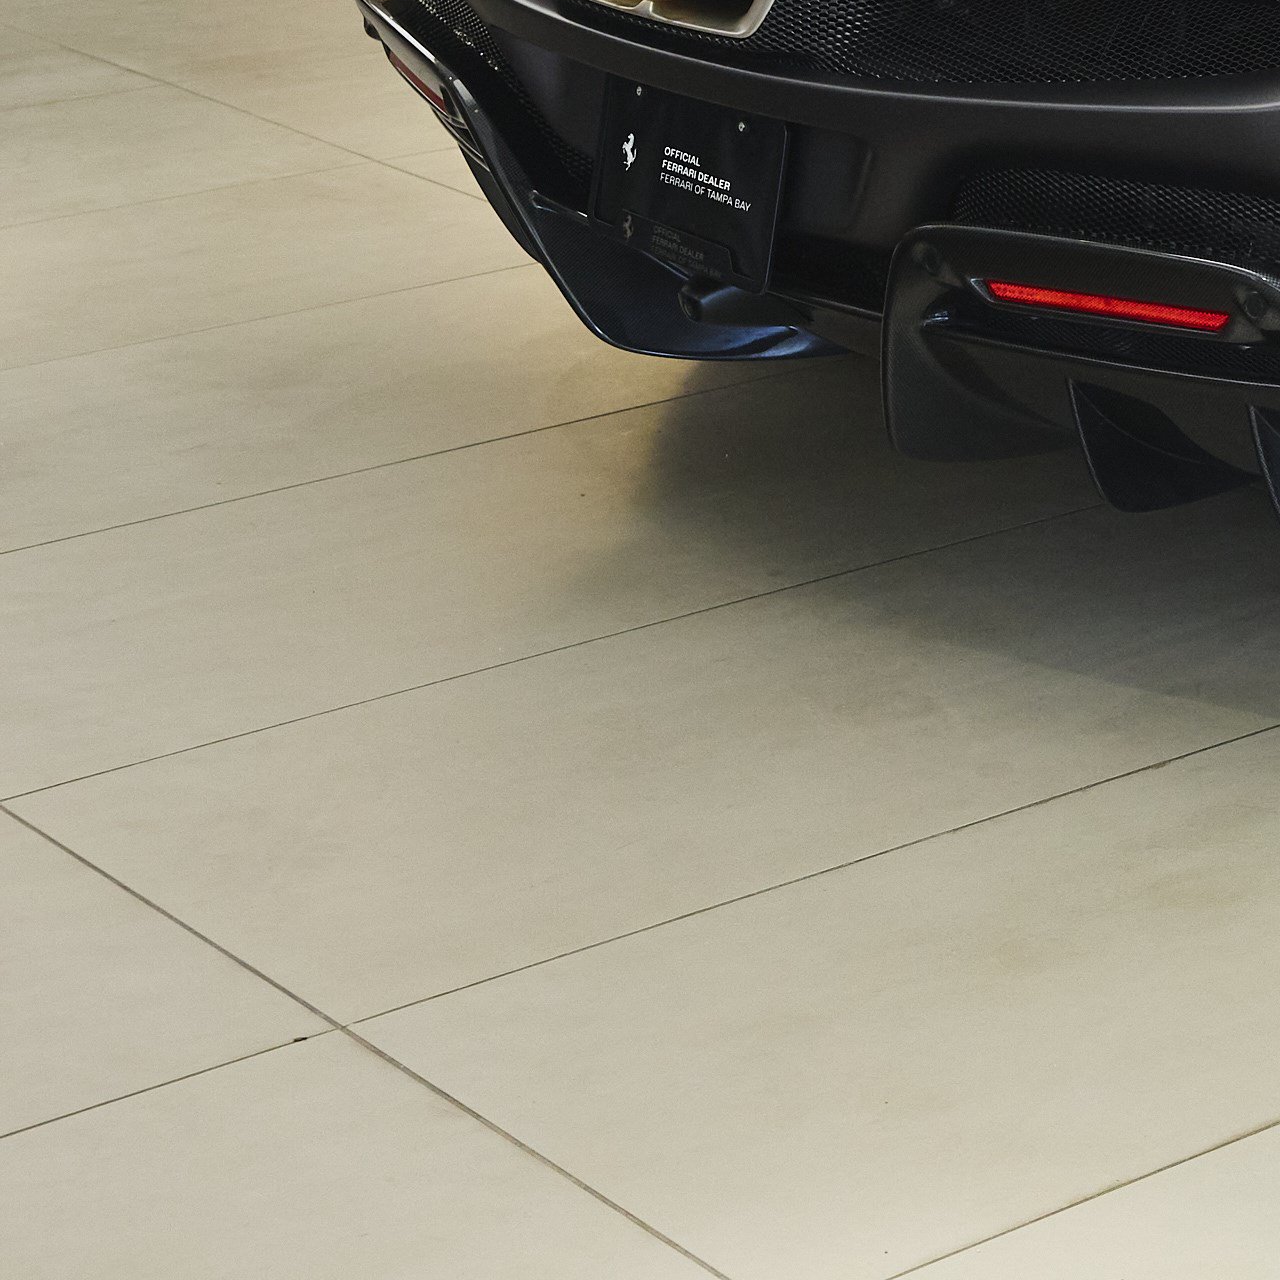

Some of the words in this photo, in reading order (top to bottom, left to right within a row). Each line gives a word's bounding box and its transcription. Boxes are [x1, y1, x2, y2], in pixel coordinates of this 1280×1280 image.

[664, 146, 700, 167] OFFICIAL
[662, 159, 697, 179] FERRARI
[698, 172, 731, 191] DEALER
[660, 172, 694, 192] FERRARI
[694, 185, 706, 195] OF
[707, 188, 733, 207] TAMPA
[734, 198, 752, 212] BAY
